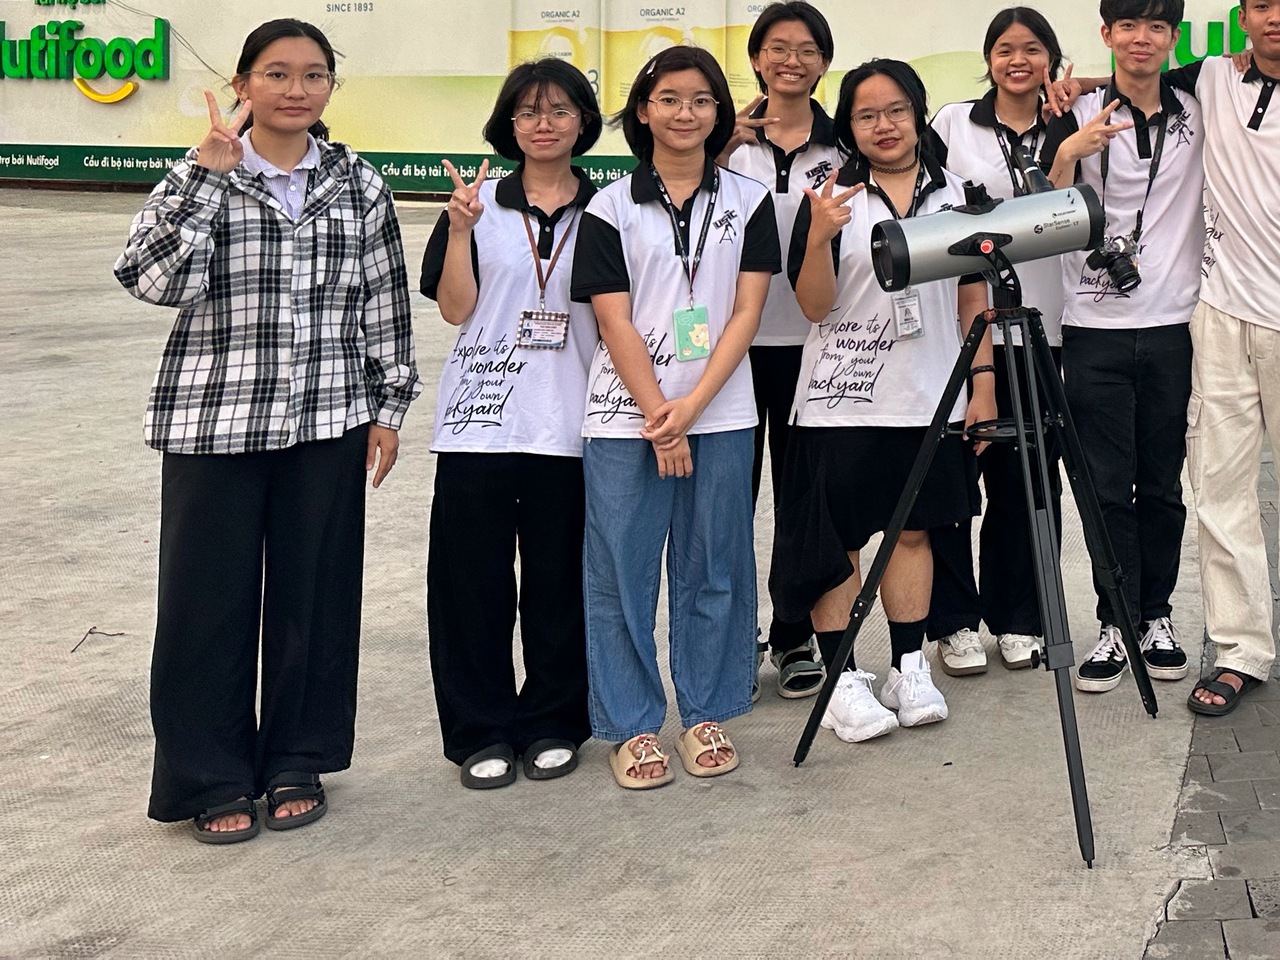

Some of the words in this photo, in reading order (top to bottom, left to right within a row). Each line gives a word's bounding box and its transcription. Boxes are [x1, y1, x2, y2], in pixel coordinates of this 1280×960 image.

[326, 3, 351, 13] SINCE
[353, 2, 374, 12] 1893
[640, 7, 674, 17] ORGANIC
[675, 7, 686, 16] A2
[747, 5, 768, 13] ORGA
[541, 10, 570, 19] ORGANIC
[571, 10, 581, 18] A2
[0, 16, 171, 81] utifood
[111, 156, 122, 170] bộ
[402, 164, 412, 176] đi
[414, 164, 427, 180] bộ
[429, 165, 442, 177] tài
[460, 165, 476, 178] bởi
[836, 318, 899, 356] wonder
